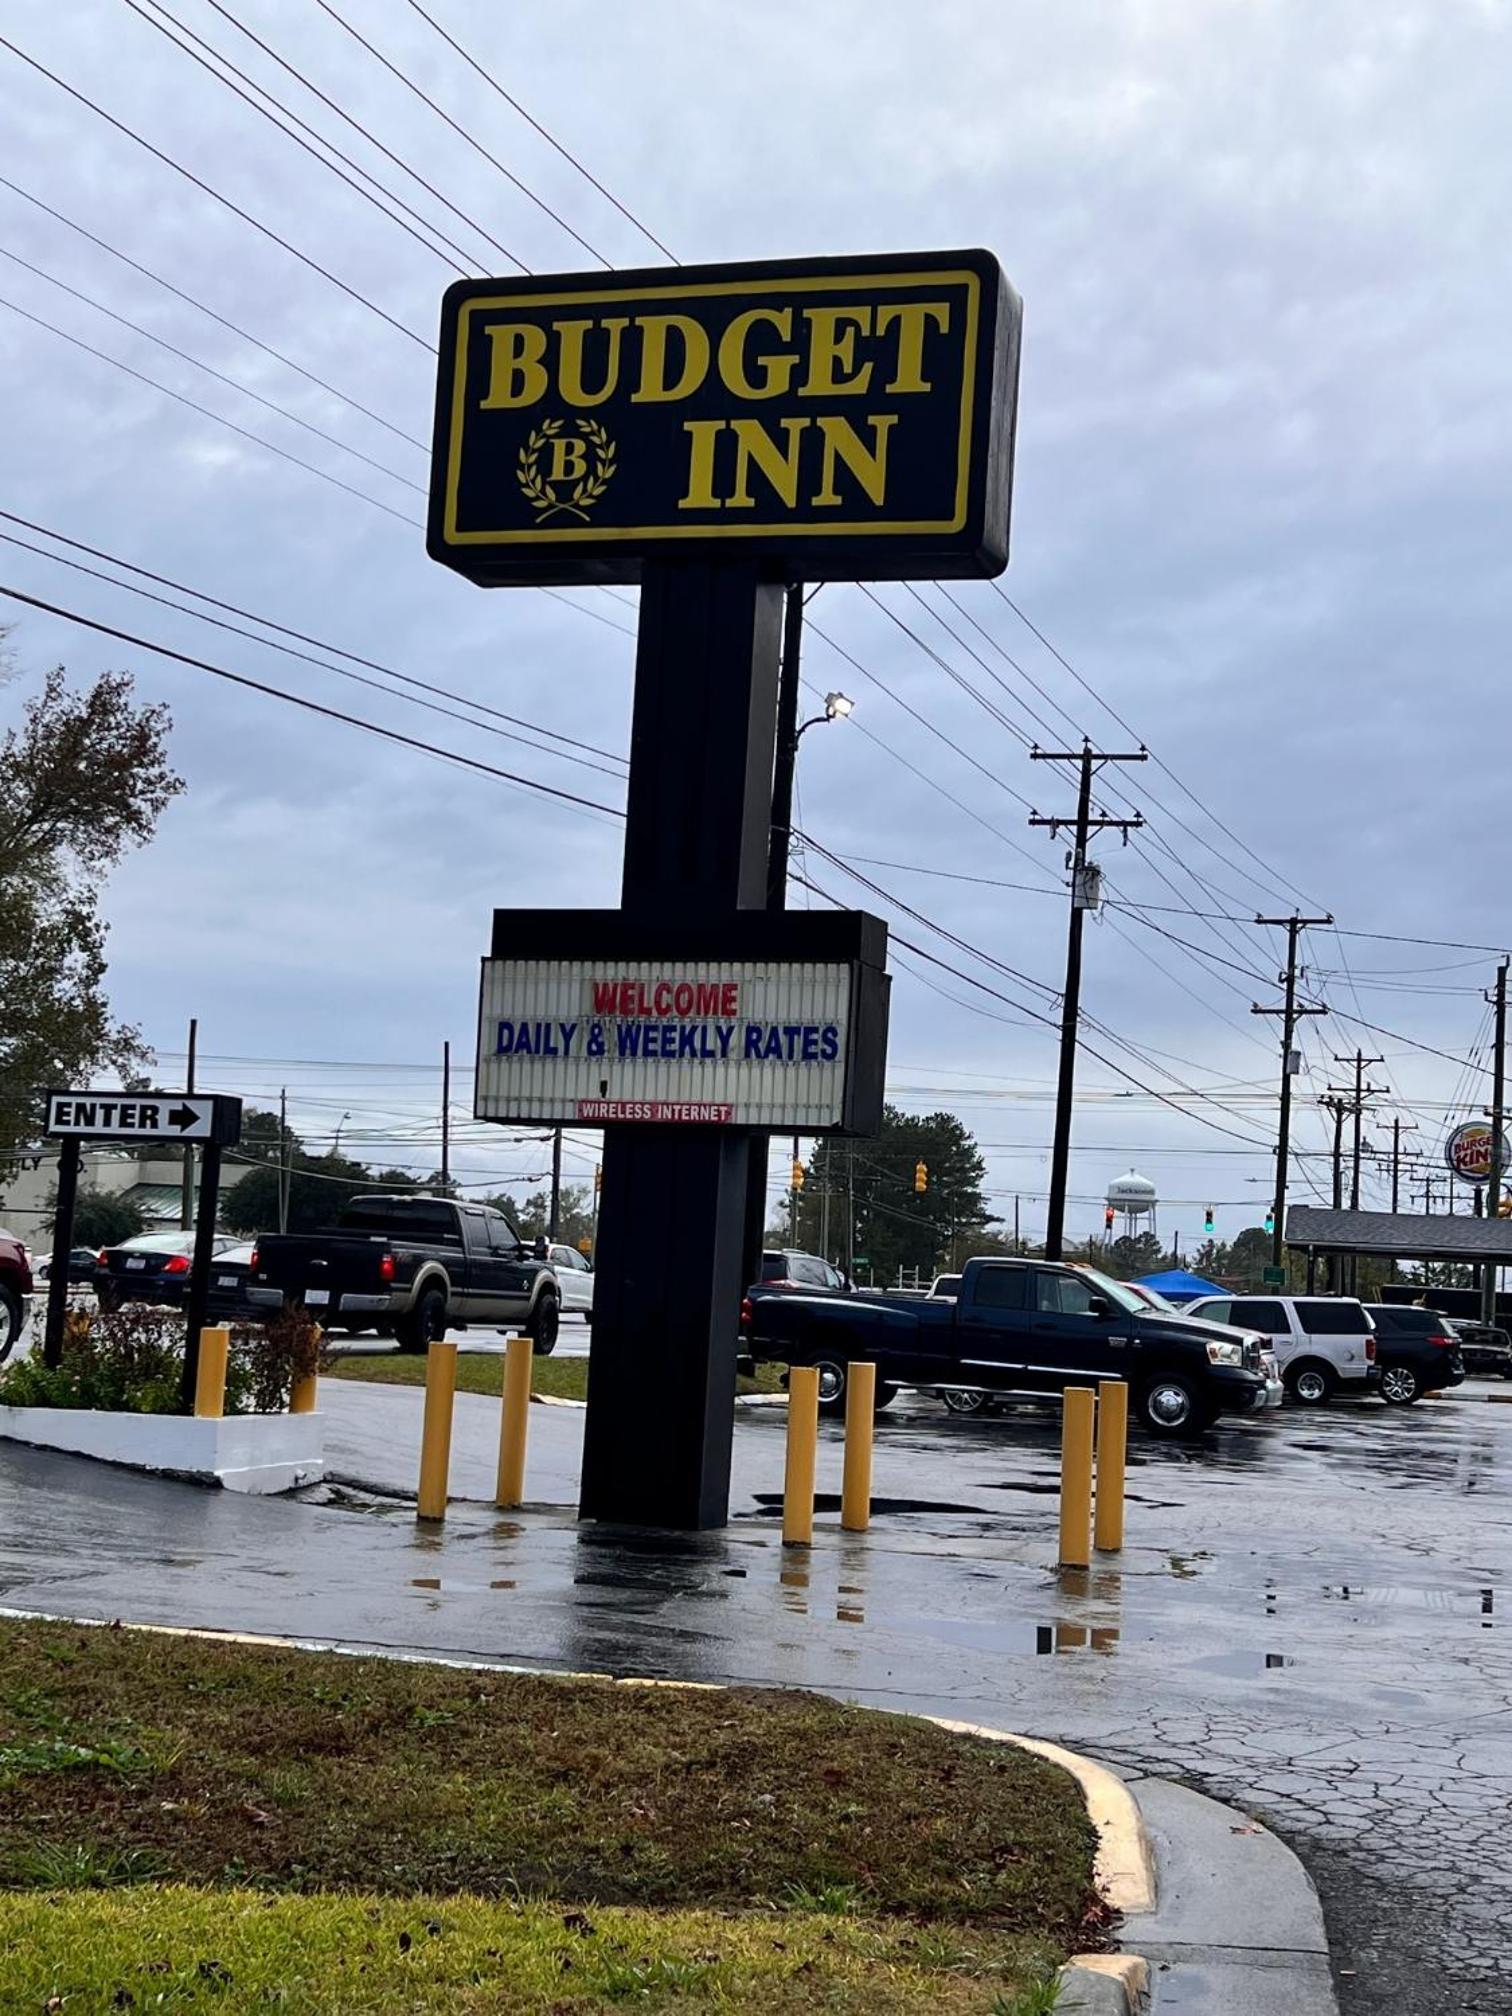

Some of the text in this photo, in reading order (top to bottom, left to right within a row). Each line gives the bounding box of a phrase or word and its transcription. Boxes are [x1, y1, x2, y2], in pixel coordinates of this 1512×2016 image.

[480, 303, 949, 409] BUDGET
[549, 438, 587, 481] B
[677, 414, 899, 509] INN
[592, 982, 738, 1017] WELCOME
[497, 1022, 840, 1061] DAILY & WEEKLY RATES
[54, 1101, 160, 1129] ENTER
[583, 1102, 728, 1121] WIRELESS INTERNET
[1454, 1136, 1495, 1154] BURGE
[1456, 1148, 1494, 1169] KIN
